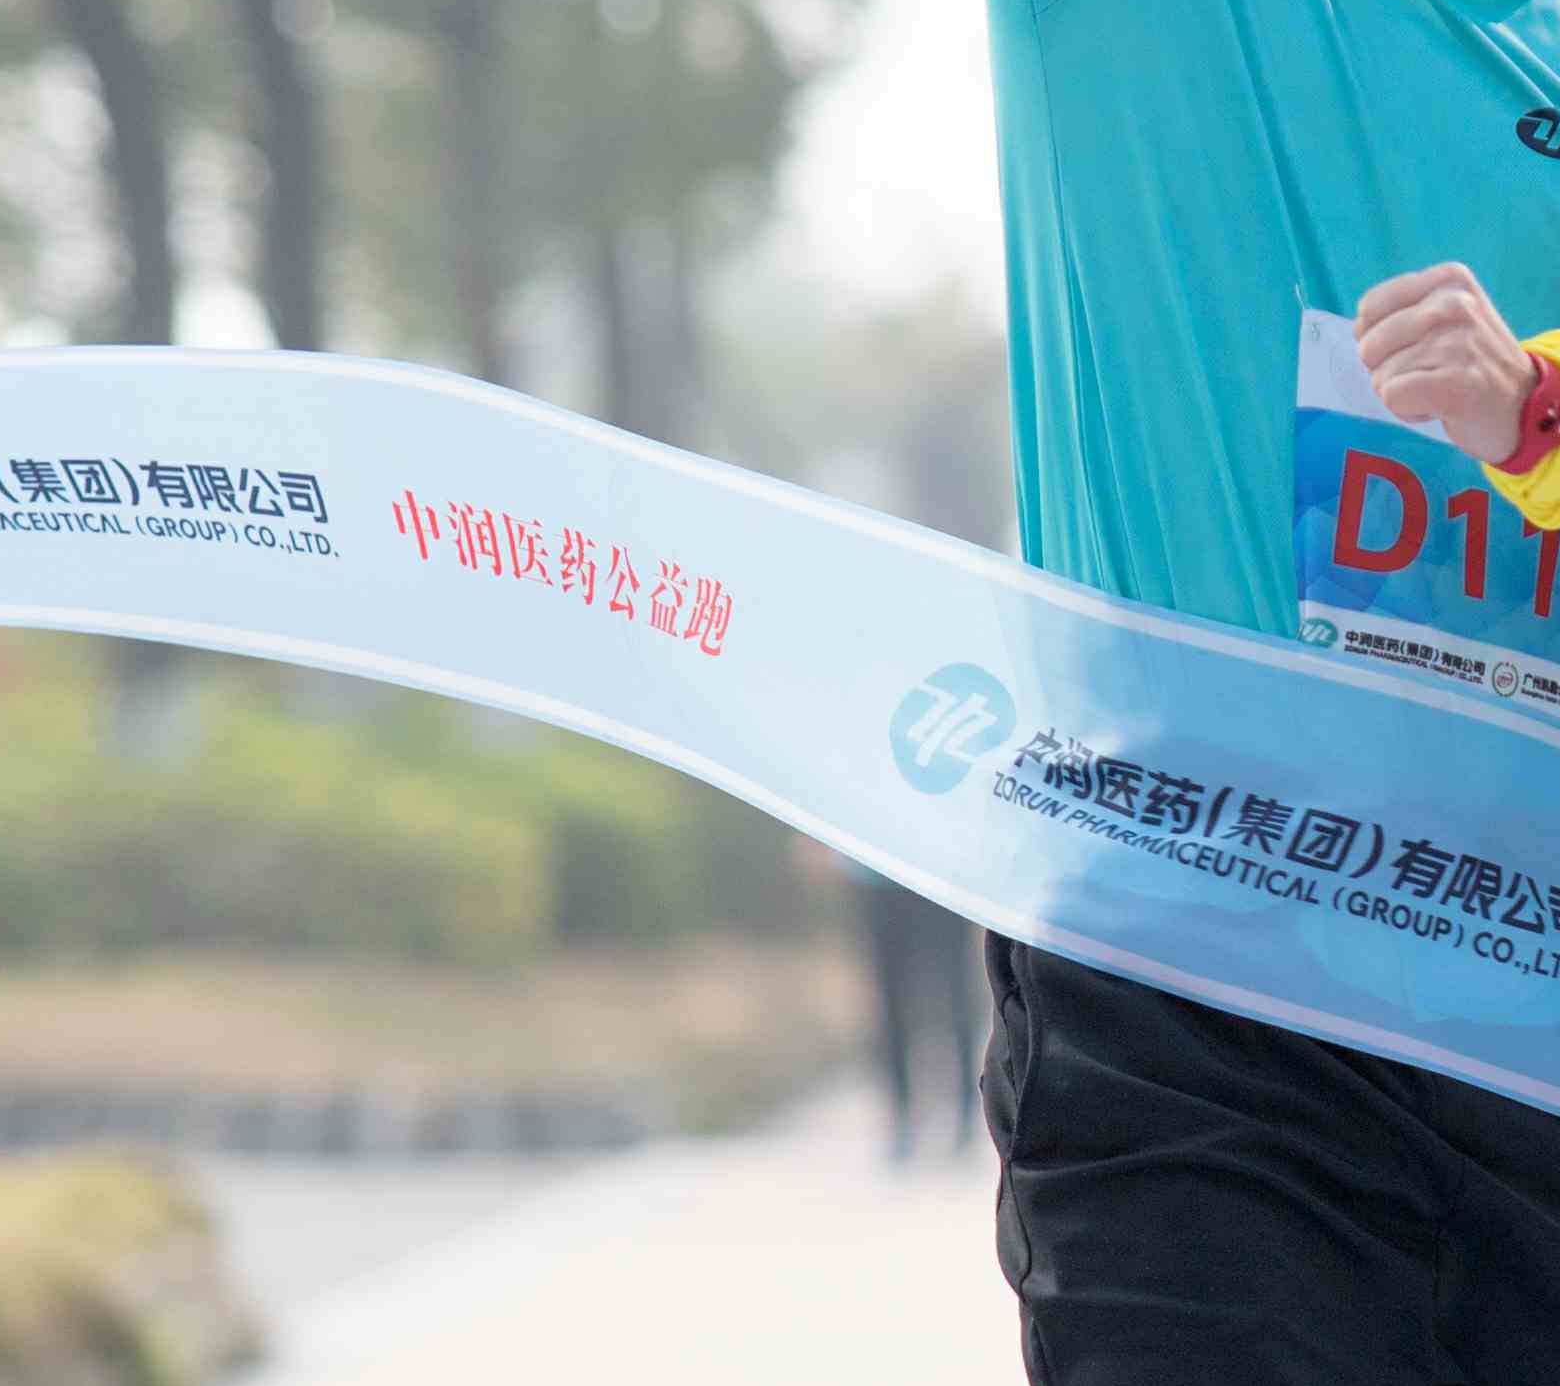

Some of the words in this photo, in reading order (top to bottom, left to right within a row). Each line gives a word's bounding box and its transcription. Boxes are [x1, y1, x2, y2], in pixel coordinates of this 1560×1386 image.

[136, 514, 238, 544] (GROUP)
[245, 524, 340, 558] CO.,LTD.
[392, 490, 732, 656] 中润医药公益跑
[992, 771, 1065, 818] ZORUN
[1064, 808, 1320, 906] PHARMACEUTICAL
[1333, 887, 1464, 948] (GROUP)
